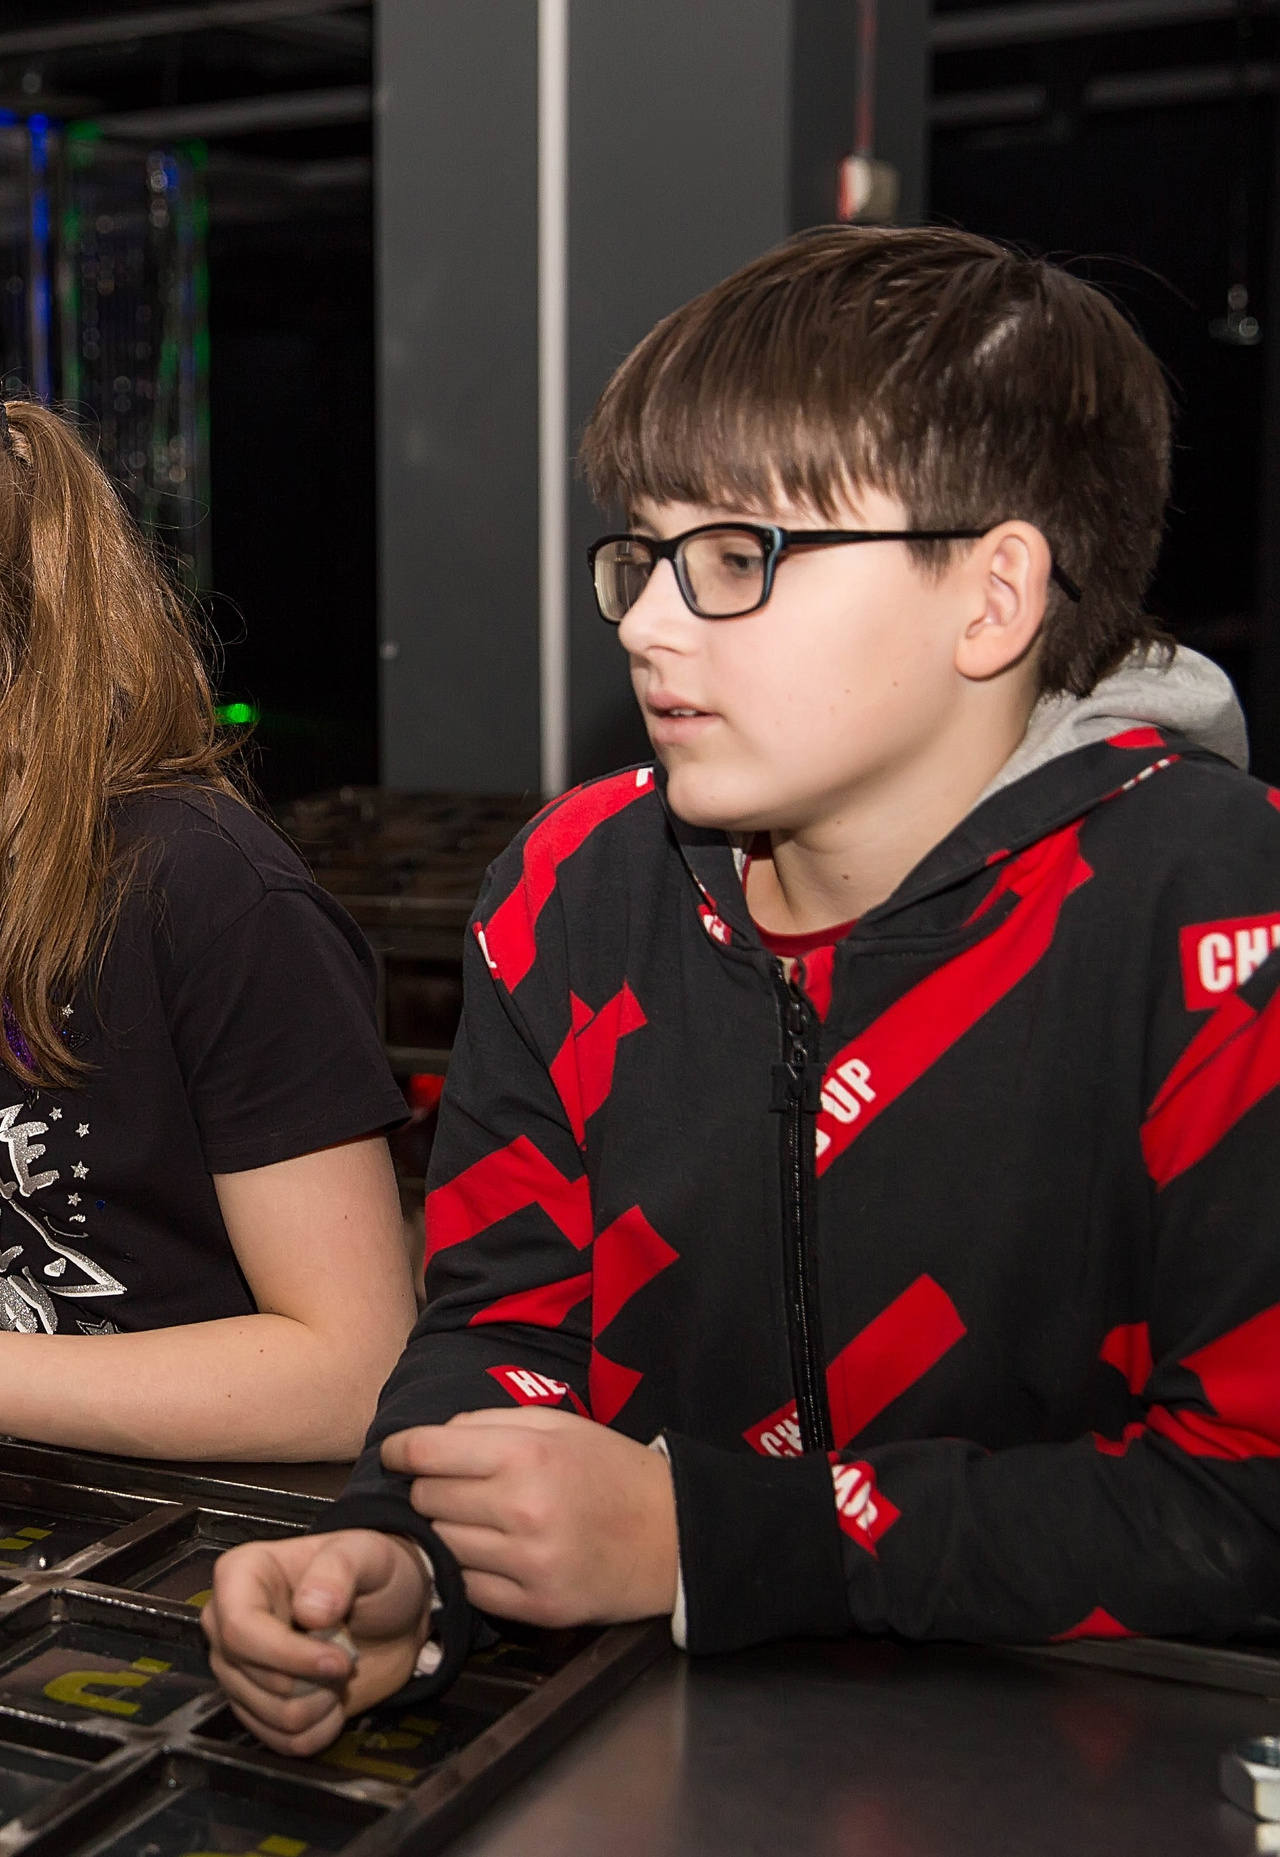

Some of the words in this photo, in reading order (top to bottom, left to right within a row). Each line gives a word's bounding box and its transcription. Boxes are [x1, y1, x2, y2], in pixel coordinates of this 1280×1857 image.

[1197, 922, 1280, 994] CH
[819, 1058, 877, 1125] UP
[759, 1410, 805, 1459] CH
